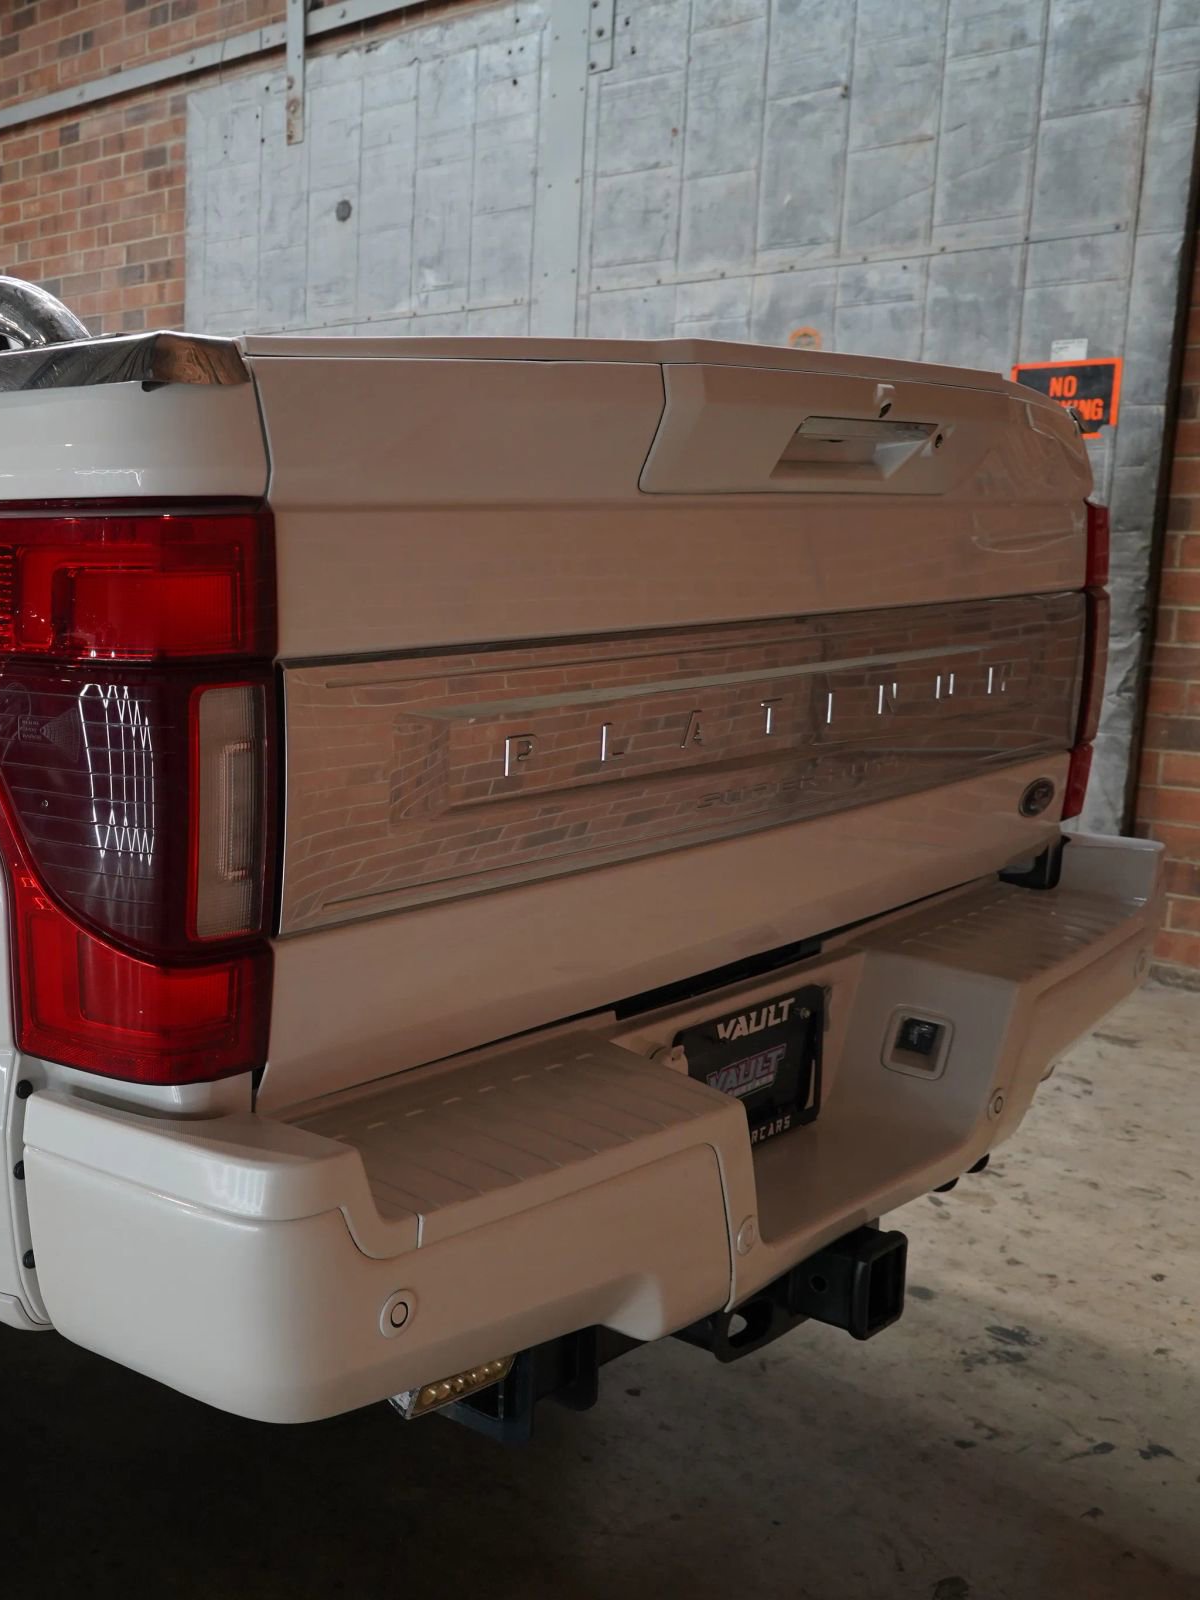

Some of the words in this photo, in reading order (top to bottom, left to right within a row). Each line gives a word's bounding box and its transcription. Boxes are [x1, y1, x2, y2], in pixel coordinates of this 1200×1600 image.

[1049, 375, 1078, 398] NO
[716, 997, 796, 1042] VAULT
[707, 1044, 787, 1093] VAULT
